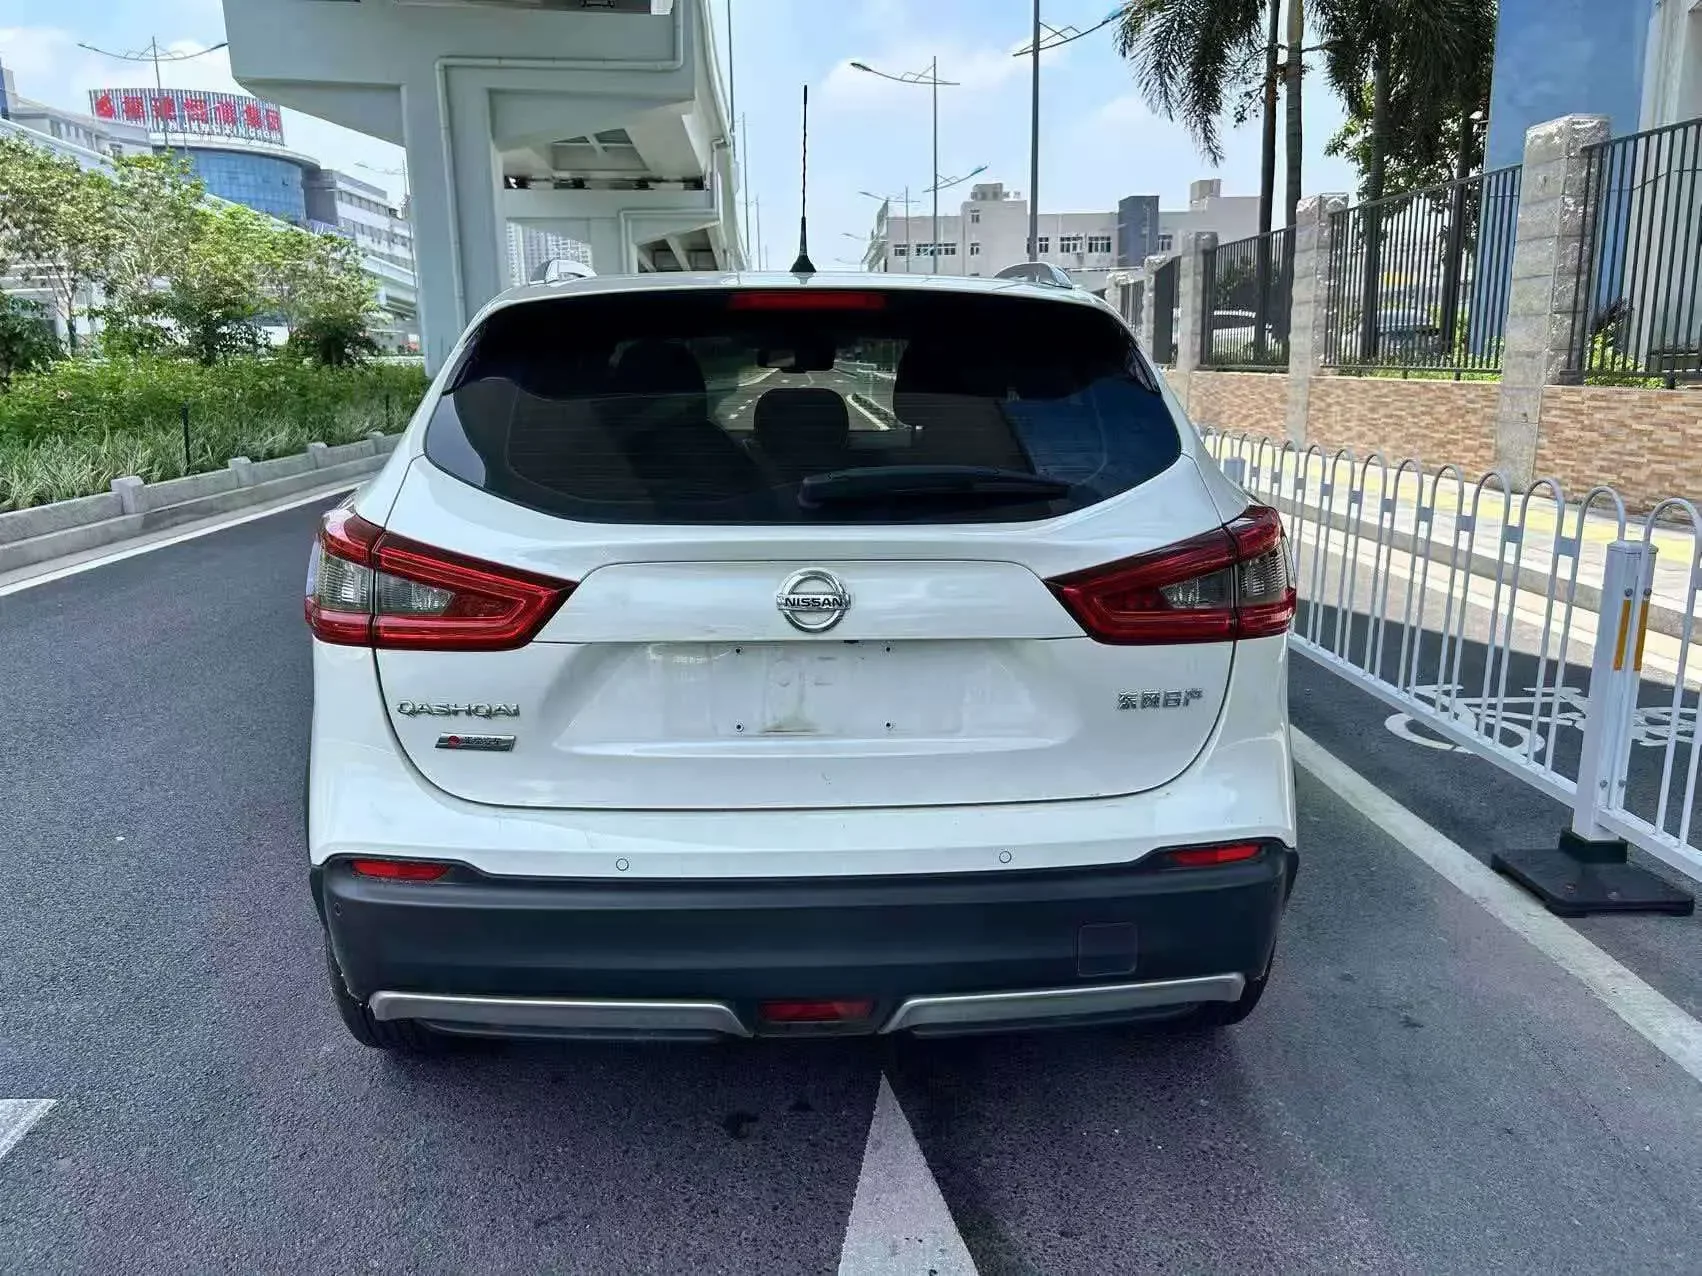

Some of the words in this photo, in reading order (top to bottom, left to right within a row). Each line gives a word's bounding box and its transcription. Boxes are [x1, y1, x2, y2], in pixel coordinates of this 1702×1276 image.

[784, 597, 843, 608] NISSAN
[1117, 689, 1203, 710] 东风日产
[397, 700, 520, 719] QASHQAI
